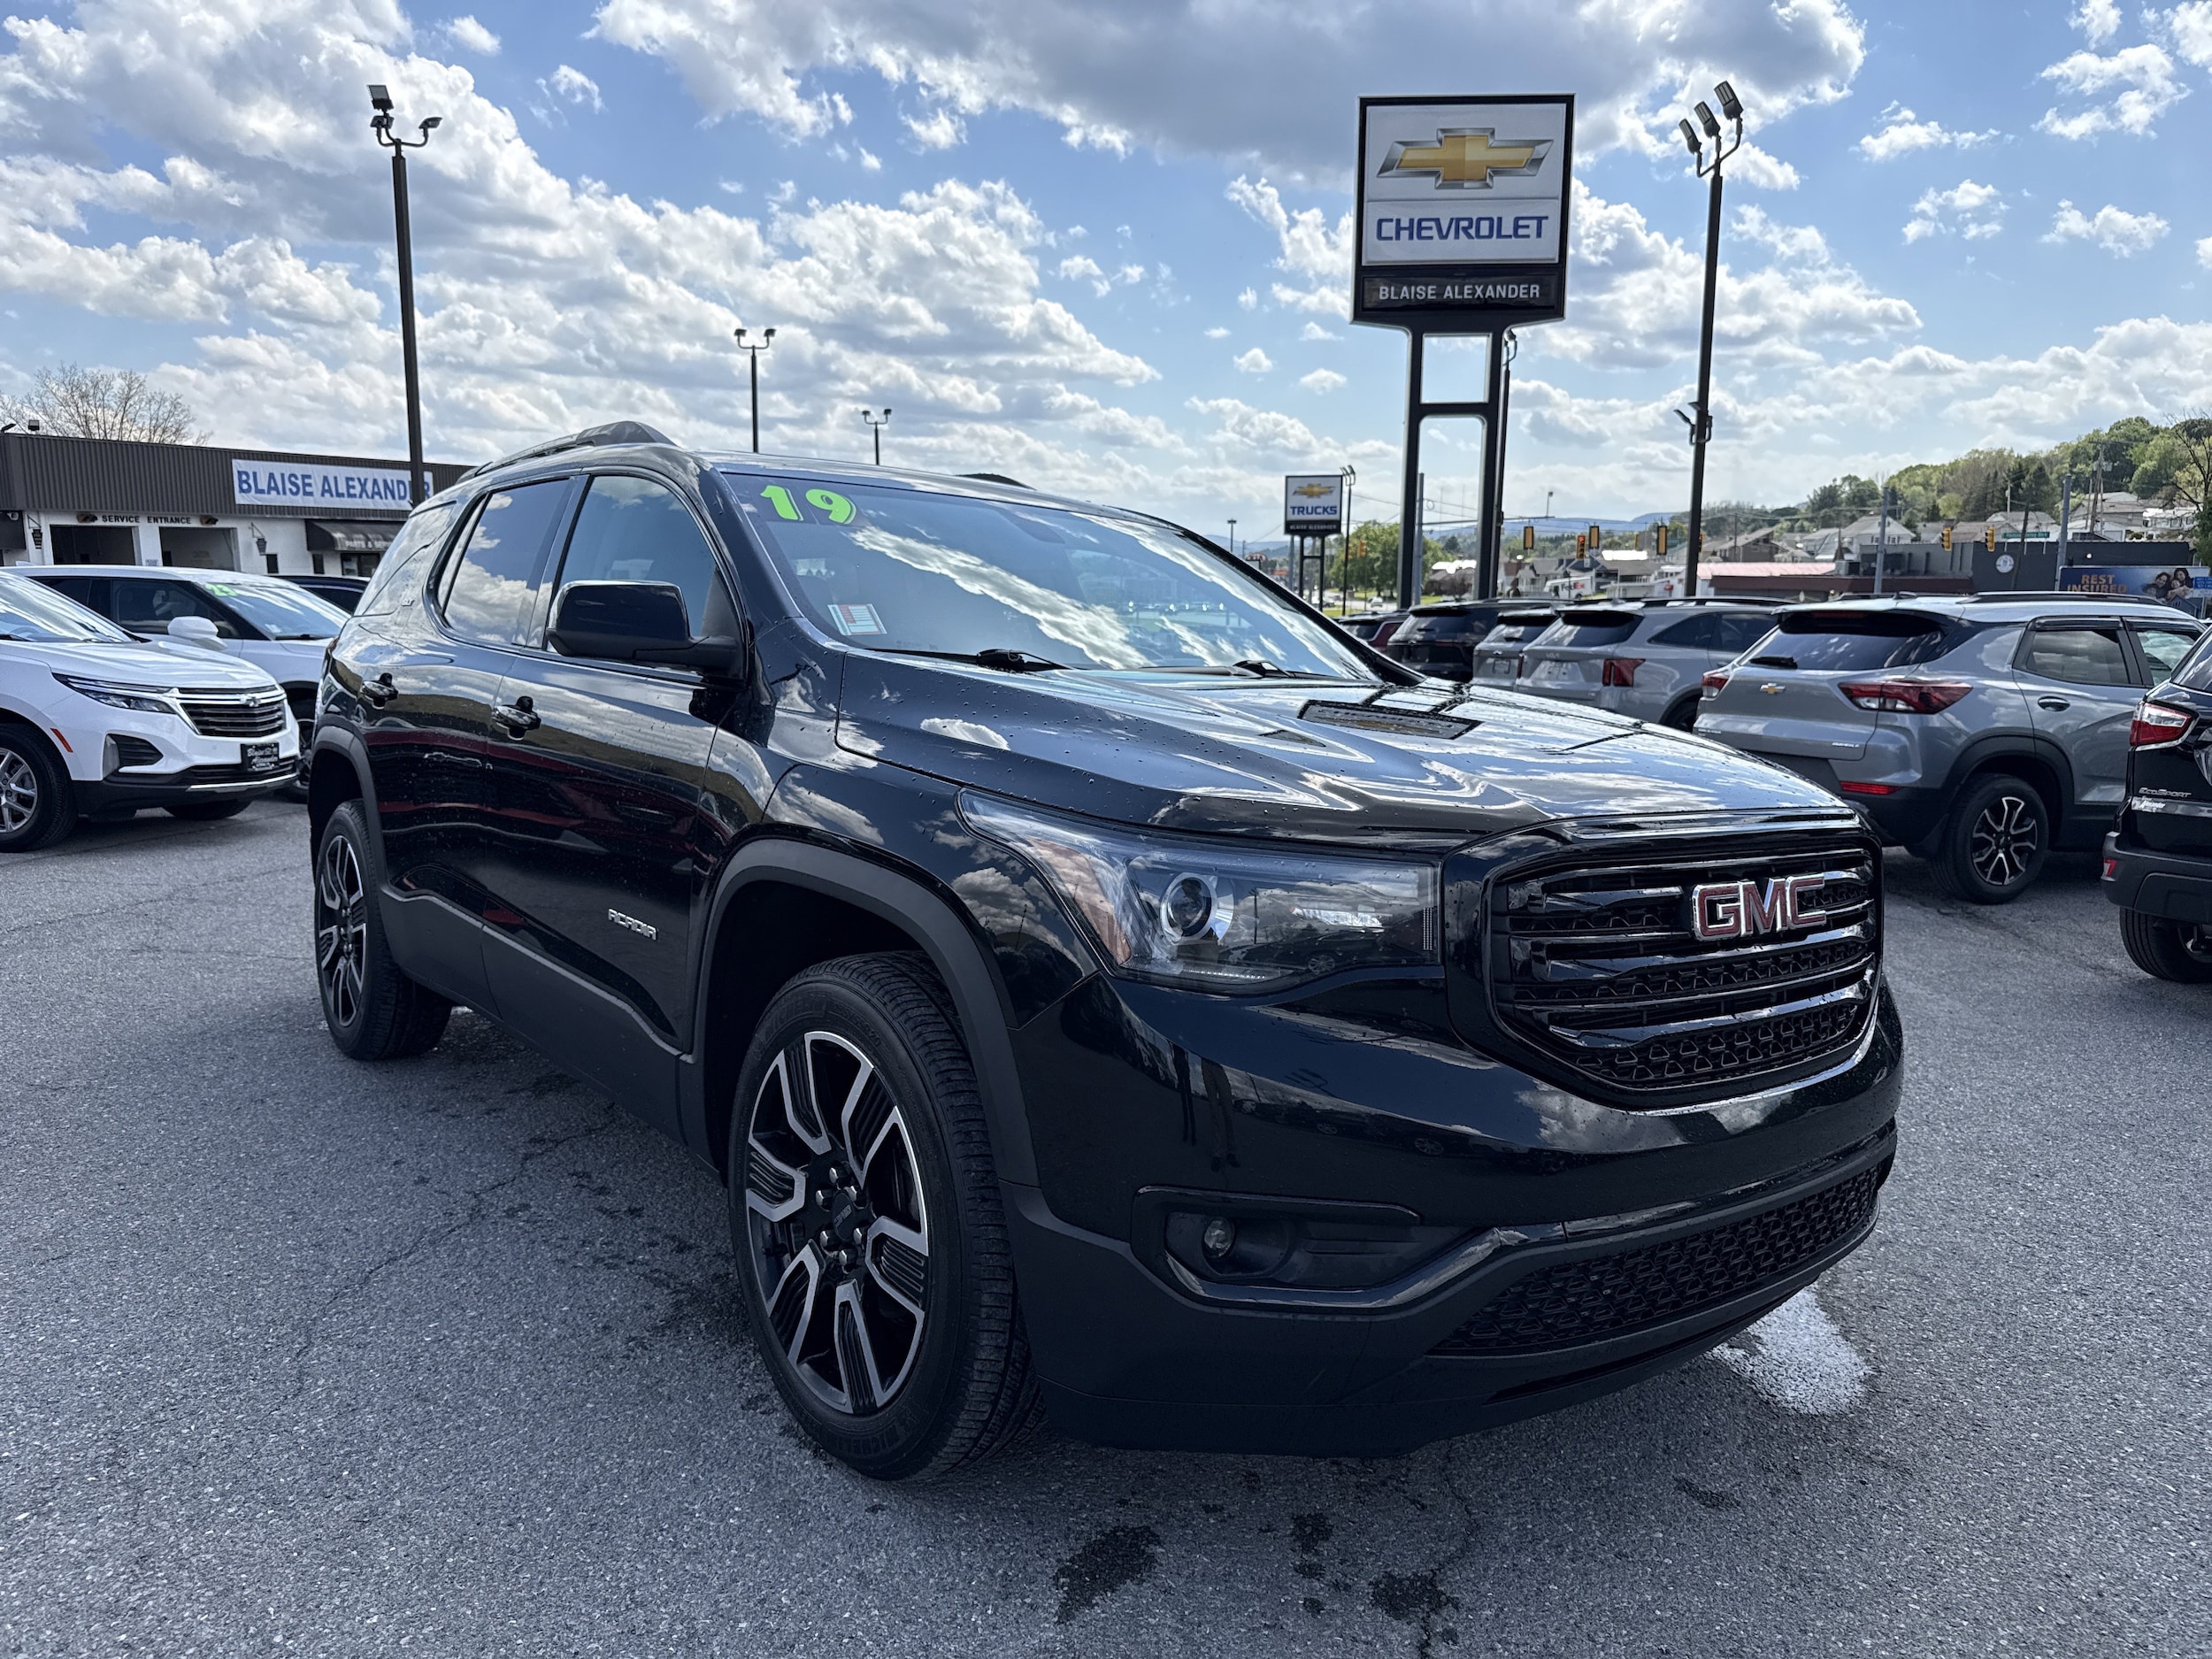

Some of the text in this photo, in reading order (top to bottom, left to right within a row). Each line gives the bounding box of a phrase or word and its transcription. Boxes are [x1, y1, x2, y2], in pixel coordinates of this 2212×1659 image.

[1376, 216, 1549, 241] CHEVROLET
[1379, 284, 1540, 300] BLAISE ALEXANDER
[237, 470, 430, 502] BLAISE ALEXANDR
[760, 485, 856, 524] 19
[1290, 505, 1337, 515] TRUCKS
[2067, 584, 2128, 594] INSURED
[2081, 574, 2116, 584] REST
[1692, 873, 1826, 942] GMC
[608, 909, 657, 941] ACADIA
